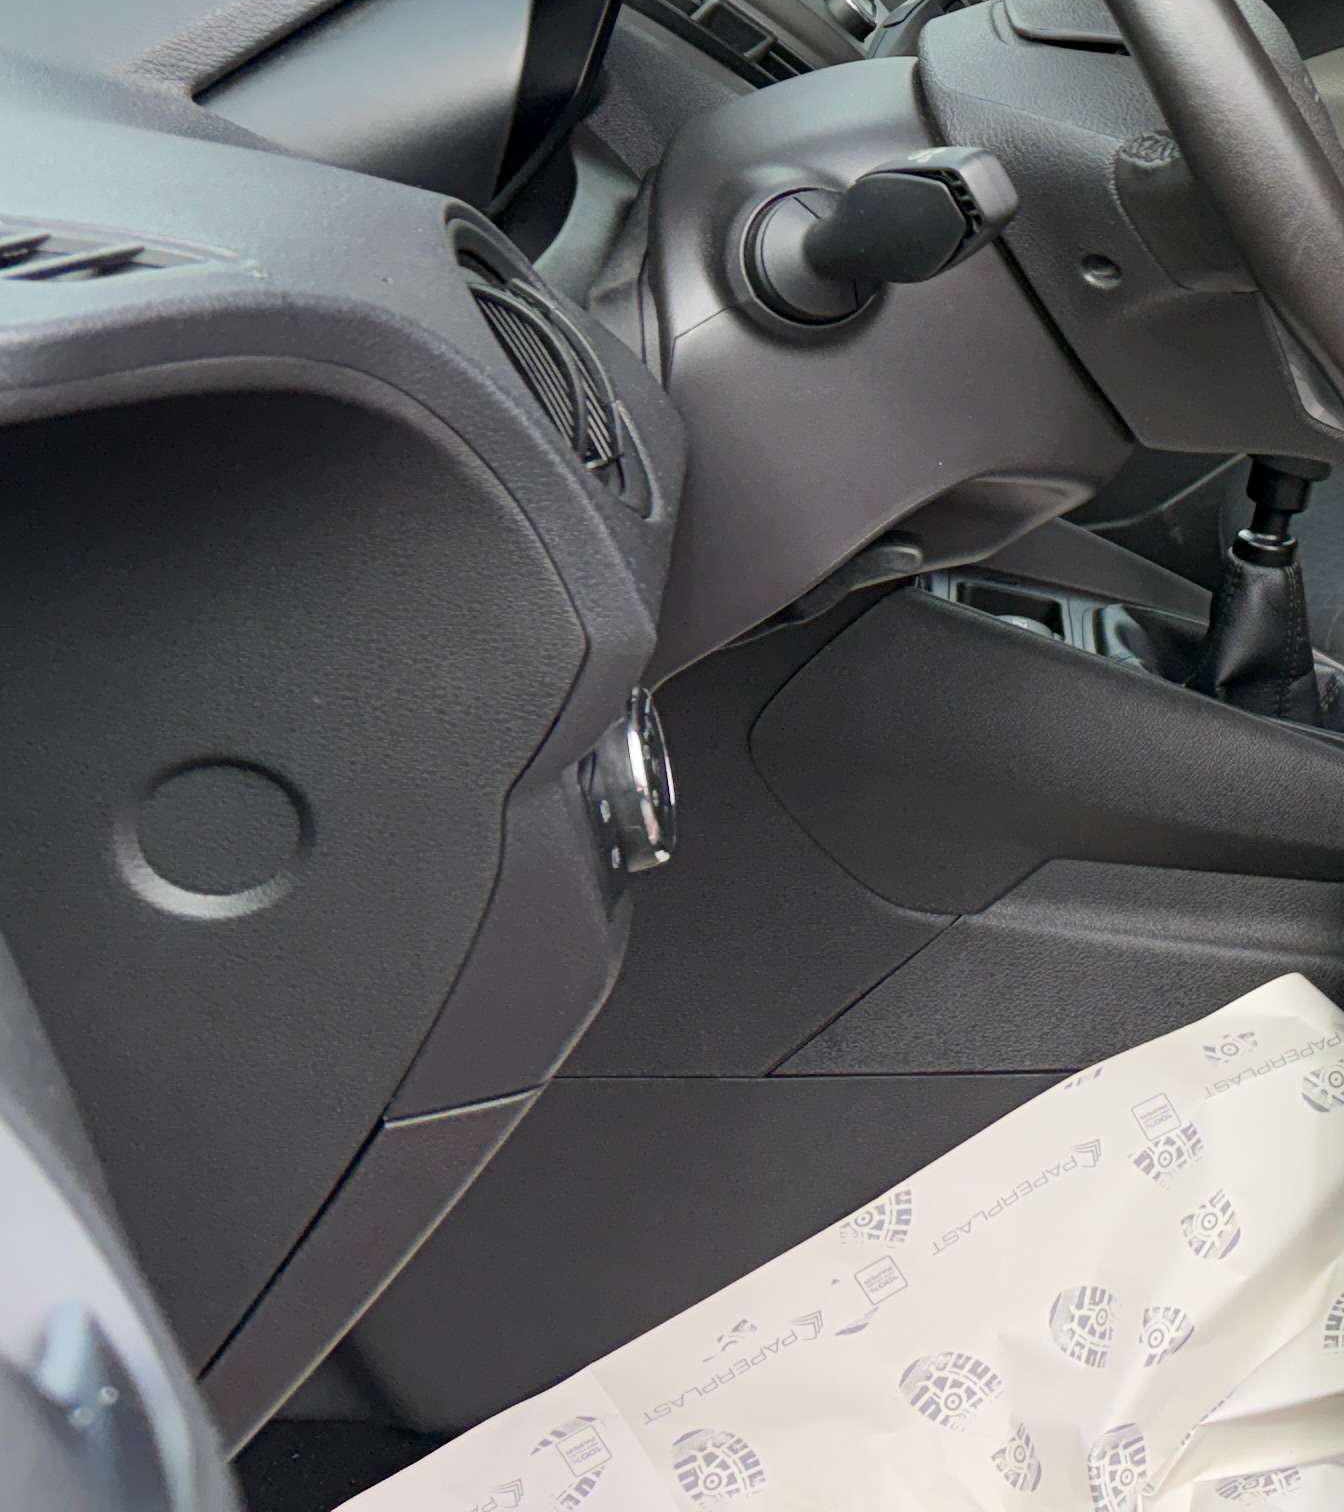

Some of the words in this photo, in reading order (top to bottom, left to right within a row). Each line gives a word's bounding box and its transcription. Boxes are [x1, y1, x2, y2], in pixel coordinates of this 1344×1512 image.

[1206, 1032, 1342, 1098] PAPERPLAST
[932, 1156, 1078, 1256] PAPERPLAST
[643, 1329, 798, 1425] PAPERPLAST
